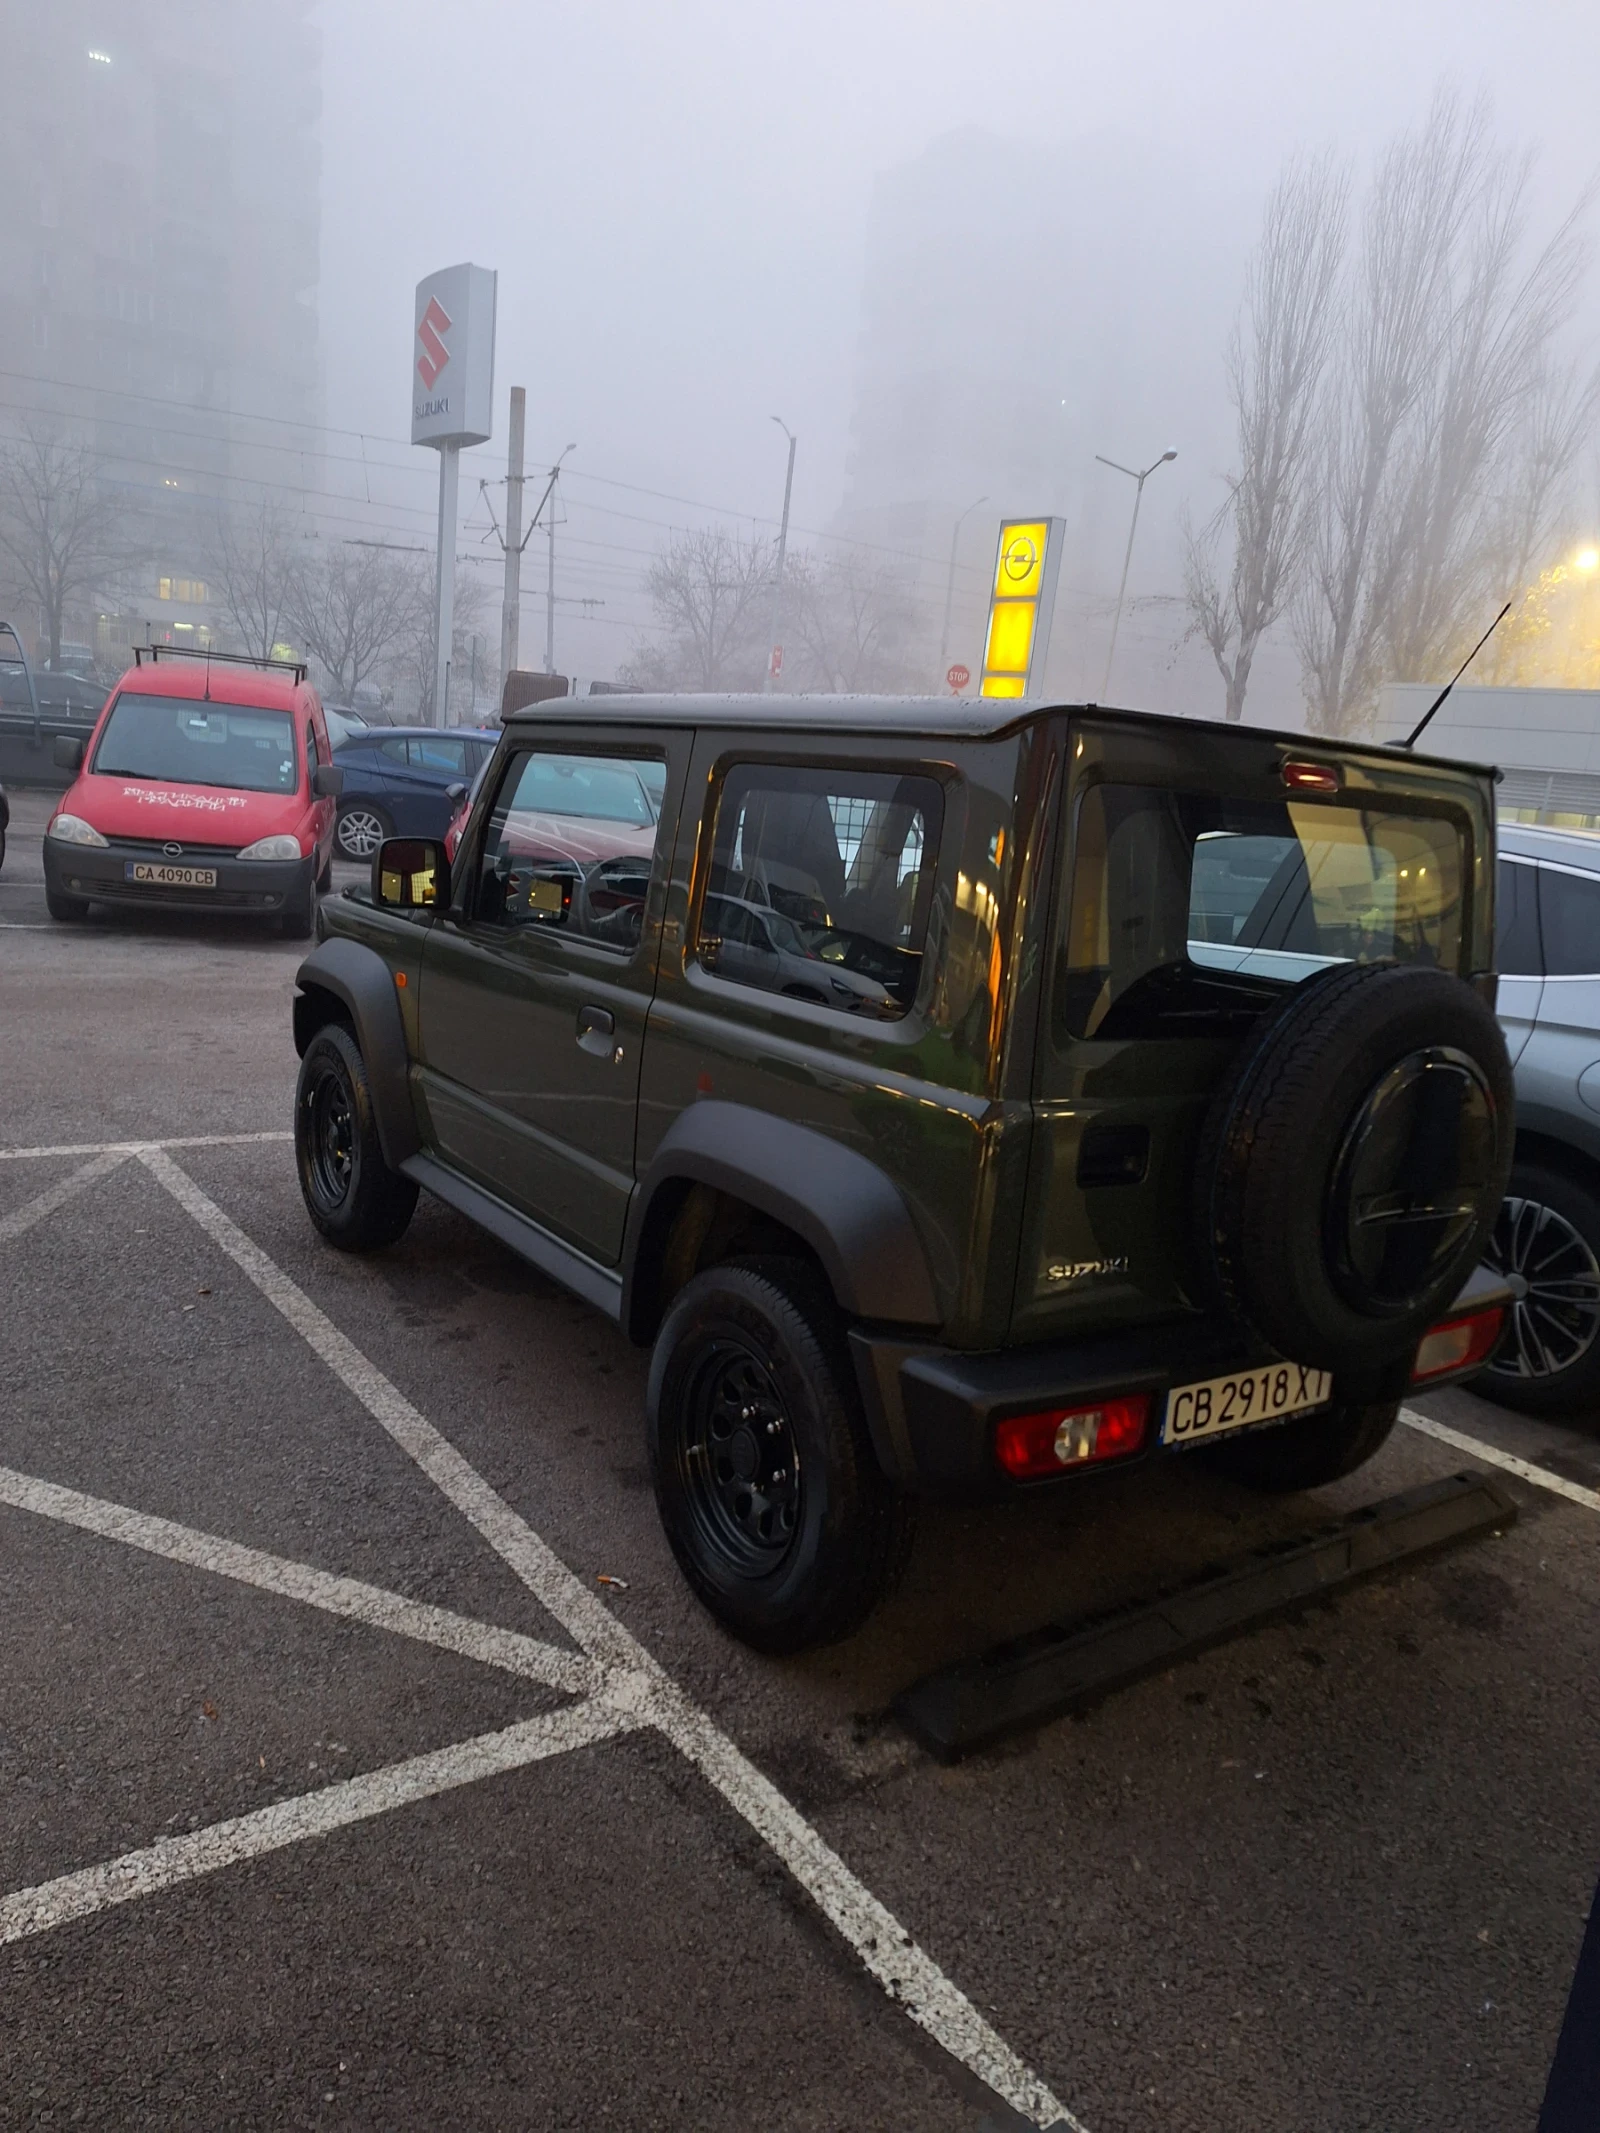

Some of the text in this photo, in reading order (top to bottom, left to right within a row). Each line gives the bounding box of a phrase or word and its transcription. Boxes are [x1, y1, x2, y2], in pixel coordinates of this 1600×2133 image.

[414, 397, 449, 420] SUZUKI
[948, 671, 968, 682] STOP
[135, 866, 214, 885] CA 4090 CB
[1047, 1256, 1128, 1280] SUZUKI
[1172, 1387, 1212, 1434] CB
[1218, 1369, 1289, 1424] 2918
